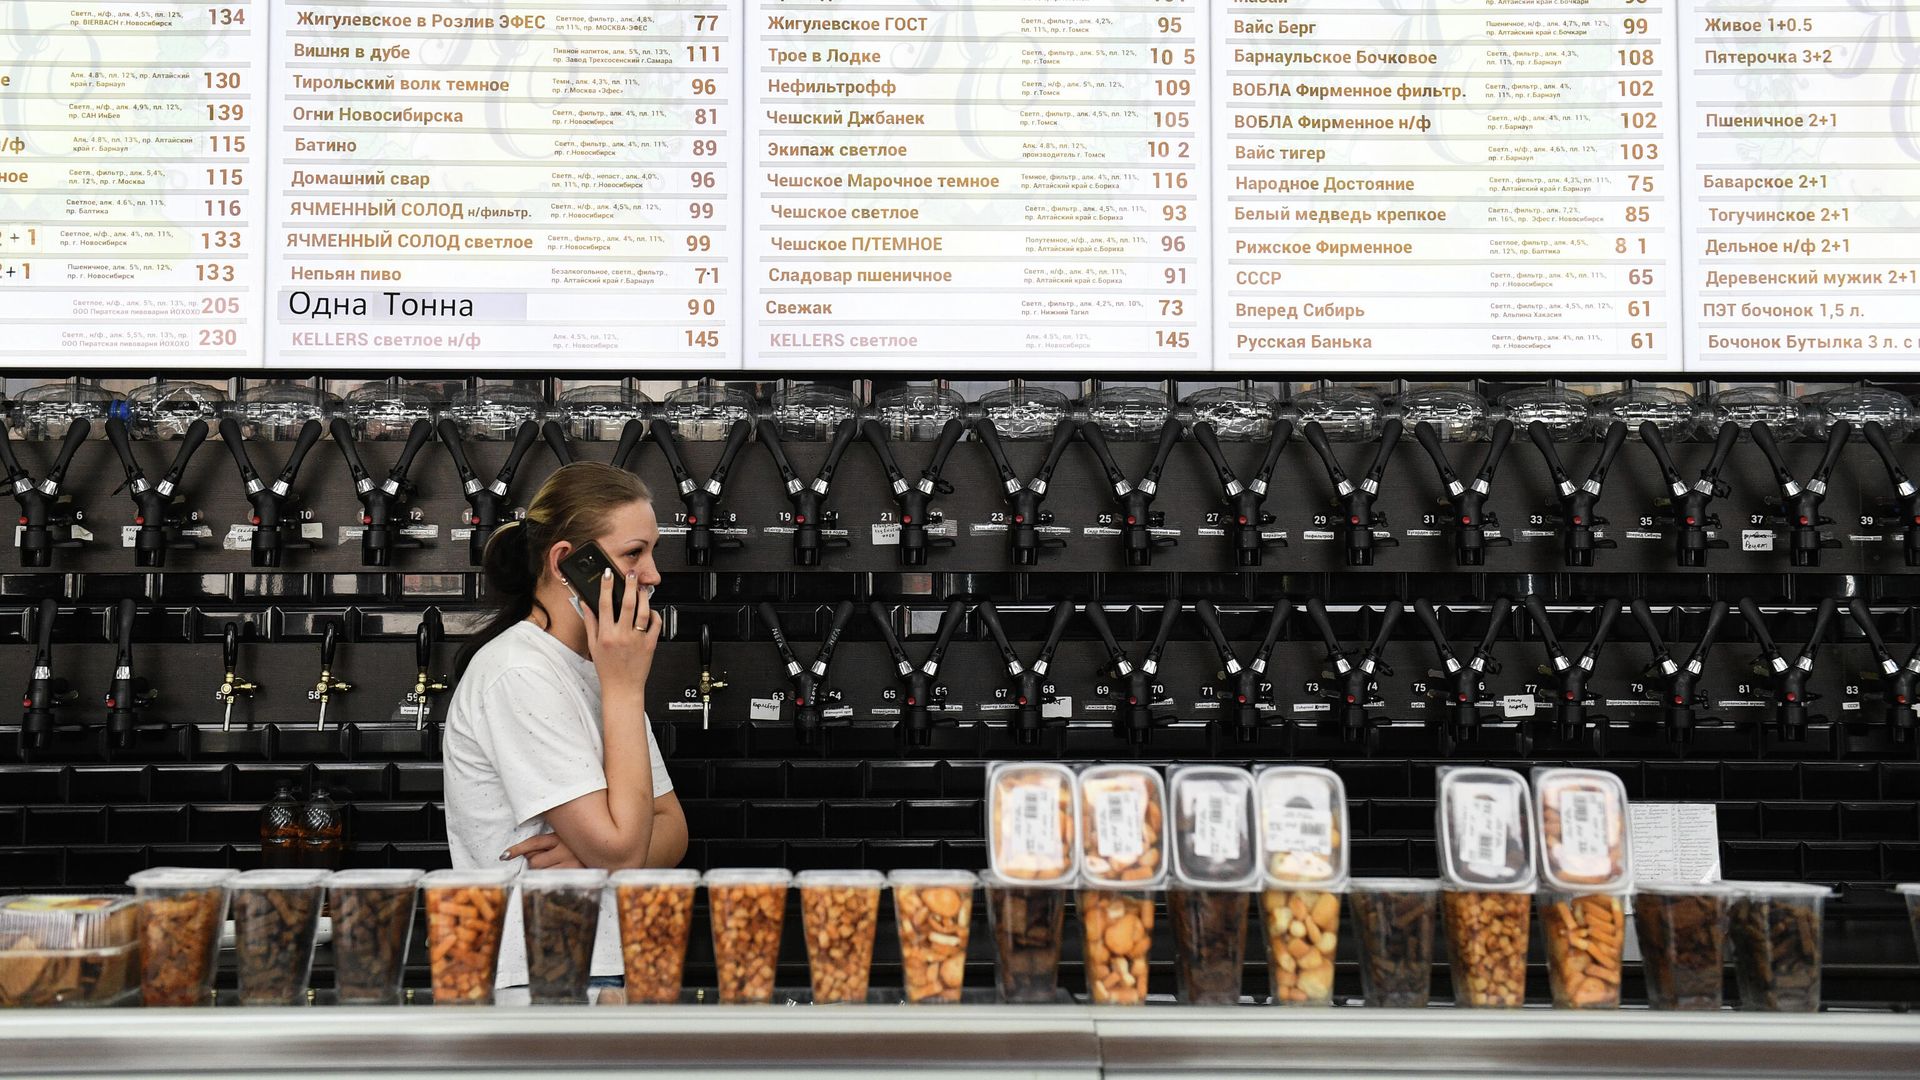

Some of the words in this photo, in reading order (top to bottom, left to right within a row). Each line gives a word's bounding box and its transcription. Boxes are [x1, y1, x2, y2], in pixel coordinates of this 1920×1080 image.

[208, 8, 246, 26] 134
[296, 11, 412, 30] Жигулевское
[417, 16, 427, 28] в
[432, 13, 495, 29] Розлив
[499, 14, 546, 29] ЭФЕС
[767, 15, 880, 34] Жигулевское
[885, 17, 928, 32] ГОСТ
[1705, 17, 1762, 32] Живое
[1767, 17, 1813, 32] 1+0.5
[1234, 19, 1274, 34] Вайс
[1278, 20, 1317, 38] Берг
[294, 43, 350, 58] Вишня
[355, 47, 365, 59] в
[369, 44, 410, 63] дубе
[686, 45, 720, 62] 111
[768, 48, 807, 65] Трое
[812, 51, 822, 63] в
[826, 48, 881, 66] Лодке
[1234, 48, 1352, 67] Барнаульское
[1356, 50, 1438, 65] Бочковое
[1618, 49, 1654, 66] 108
[1705, 50, 1797, 67] Пятерочка
[1803, 49, 1833, 64] 3+2
[203, 71, 241, 89] 130
[293, 74, 395, 92] Тирольский
[400, 79, 441, 91] волк
[446, 80, 510, 92] темное
[691, 78, 717, 96] 96
[768, 78, 897, 97] Нефильтрофф
[1155, 79, 1191, 96] 109
[1232, 82, 1292, 97] ВОБЛА
[1295, 83, 1392, 101] Фирменное
[1396, 82, 1466, 101] фильтр.
[206, 103, 244, 121] 139
[293, 106, 334, 121] Огни
[339, 107, 463, 126] Новосибирска
[766, 109, 843, 125] Чешский
[847, 110, 925, 128] Джбанек
[1706, 113, 1804, 128] Пшеничное
[1808, 113, 1837, 127] 2+1
[209, 135, 246, 153] 115
[295, 137, 357, 153] Батино
[692, 139, 717, 156] 89
[768, 142, 835, 157] Экипаж
[839, 145, 907, 157] светлое
[1235, 144, 1275, 160] Вайс
[1279, 149, 1326, 163] тигер
[291, 170, 385, 188] Домашний
[390, 174, 430, 189] свар
[767, 173, 843, 188] Чешское
[847, 173, 933, 191] Марочное
[937, 177, 999, 188] темное
[1152, 172, 1188, 189] 116
[1236, 176, 1319, 193] Народное
[1323, 176, 1415, 194] Достояние
[1704, 174, 1794, 192] Баварское
[1798, 174, 1827, 189] 2+1
[204, 199, 242, 217] 116
[1235, 206, 1290, 220] Белый
[1295, 210, 1372, 224] медведь
[1377, 210, 1446, 225] крепкое
[1625, 206, 1650, 222] 85
[201, 230, 241, 250] 133
[287, 230, 393, 248] ЯЧМЕННЫЙ
[397, 233, 461, 251] СОЛОД
[464, 237, 533, 249] светлое
[686, 235, 711, 252] 99
[771, 237, 847, 251] Чешское
[852, 236, 943, 252] П/ТЕМНОЕ
[1705, 239, 1778, 256] Дельное
[1783, 238, 1816, 257] н/ф
[1821, 238, 1849, 253] 2+1
[291, 266, 355, 281] Непьян
[360, 270, 402, 281] пиво
[768, 267, 853, 286] Сладовар
[857, 271, 952, 282] пшеничное
[1236, 271, 1282, 285] СССР
[1629, 268, 1653, 285] 65
[1705, 269, 1818, 288] Деревенский
[1823, 273, 1882, 288] мужик
[1888, 270, 1916, 284] 2+1
[201, 297, 239, 314] 205
[289, 291, 367, 320] Одна
[382, 291, 473, 317] Тонна
[766, 300, 833, 314] Свежак
[1236, 303, 1298, 320] Вперед
[1303, 302, 1365, 321] Сибирь
[1703, 304, 1736, 317] ПЭТ
[1741, 303, 1813, 317] бочонок
[1820, 303, 1844, 319] 1,5
[1850, 306, 1864, 317] л.
[199, 329, 237, 346] 230
[685, 330, 719, 348] 145
[1237, 334, 1306, 352] Русская
[1311, 334, 1372, 349] Банька
[76, 511, 83, 519] 6
[191, 511, 198, 520] 8
[300, 510, 312, 519] 10
[410, 511, 422, 520] 12
[674, 512, 687, 522] 17
[779, 512, 791, 520] 19
[880, 512, 892, 521] 21
[991, 512, 1004, 521] 23
[1099, 514, 1112, 523] 25
[1206, 513, 1219, 521] 27
[1314, 515, 1327, 524] 29
[1423, 514, 1435, 523] 31
[1530, 515, 1543, 523] 33
[1640, 516, 1653, 525] 35
[1751, 514, 1764, 523] 37
[1860, 516, 1873, 524] 39
[685, 688, 697, 697] 62
[883, 690, 896, 698] 65
[995, 689, 1007, 697] 67
[1042, 684, 1055, 693] 68
[1097, 685, 1109, 694] 69
[1202, 687, 1213, 695] 71
[1413, 683, 1426, 691] 75
[1631, 683, 1643, 691] 79
[1739, 684, 1750, 693] 81
[1846, 685, 1859, 694] 83
